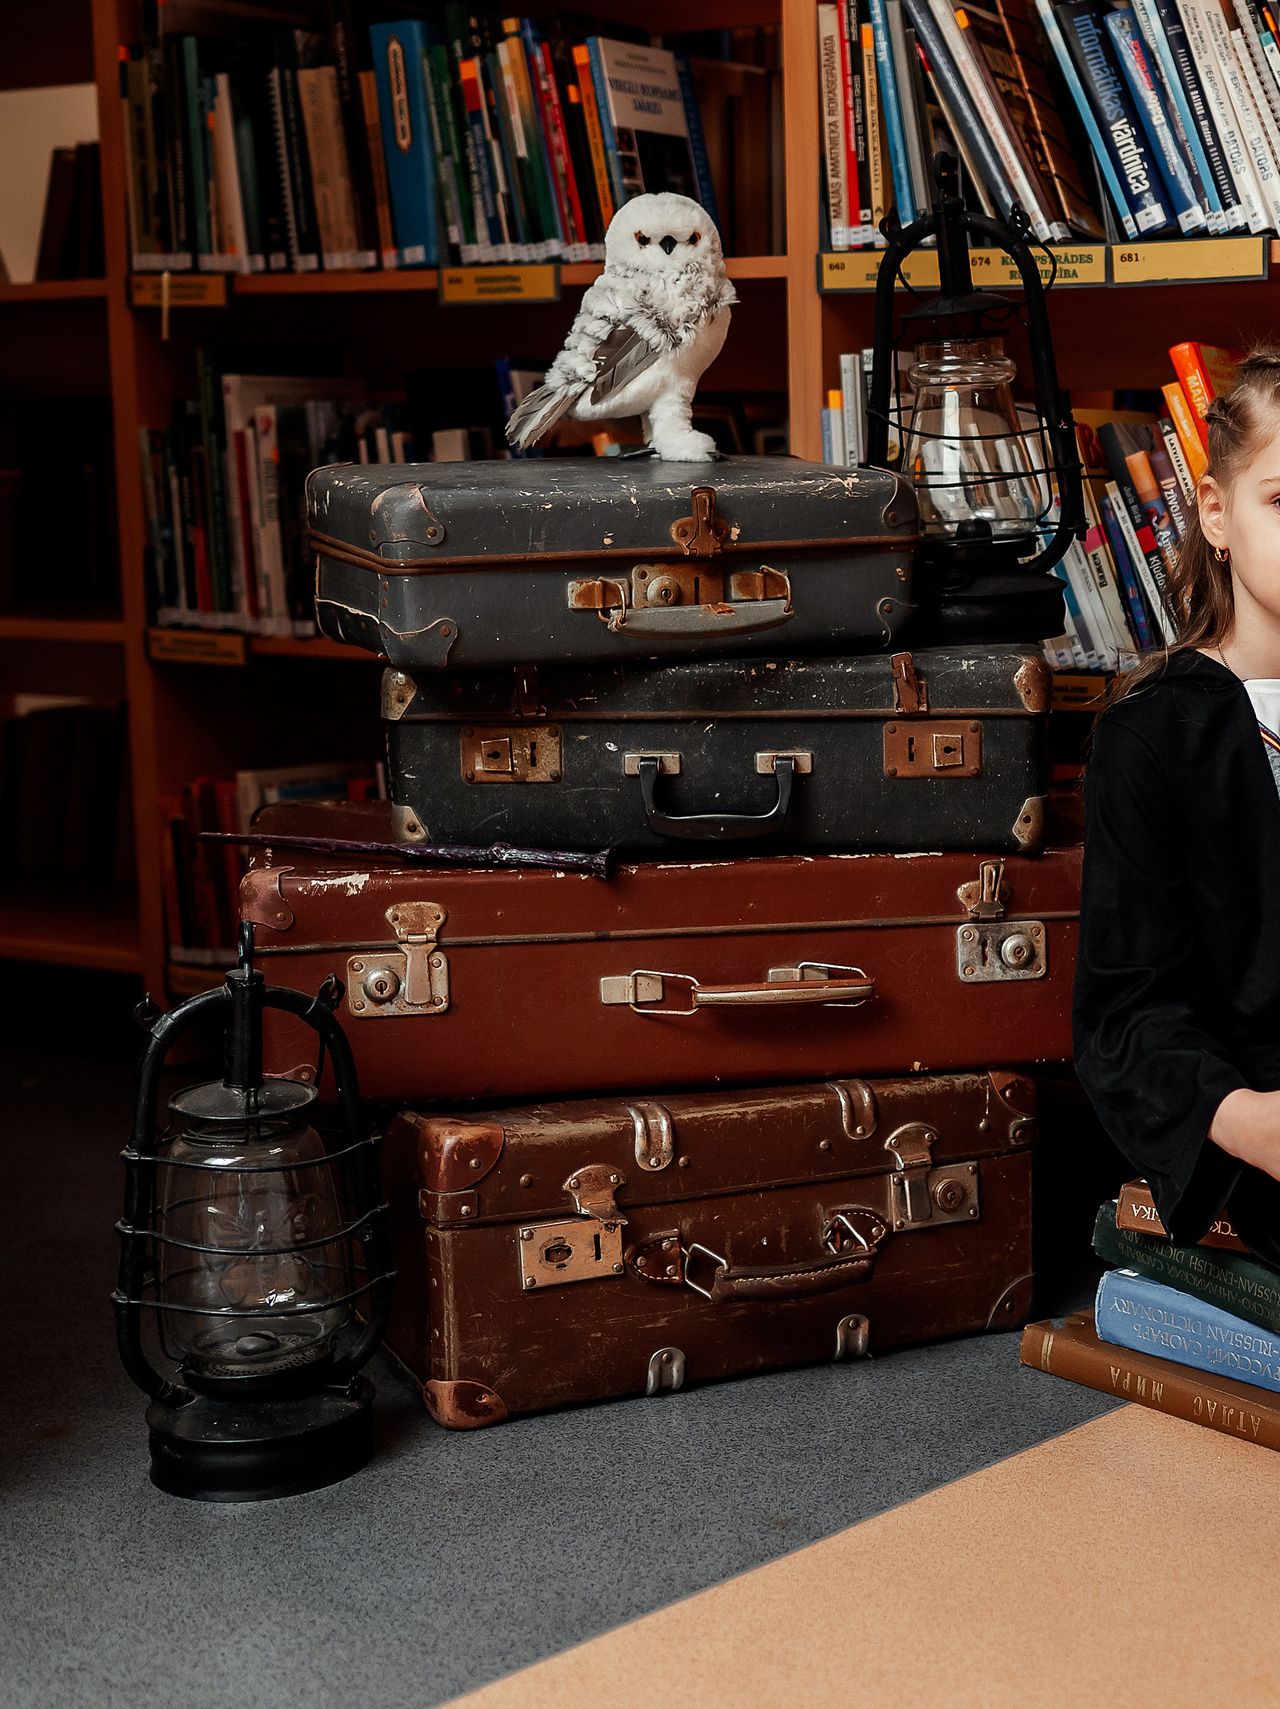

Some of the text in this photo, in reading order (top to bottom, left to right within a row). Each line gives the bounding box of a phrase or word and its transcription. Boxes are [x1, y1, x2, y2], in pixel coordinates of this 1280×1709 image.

[823, 35, 839, 117] ROKASGRĀMATA
[1073, 13, 1150, 195] informātikas vārdnīca
[828, 120, 842, 179] AMATNIEKA
[1225, 131, 1246, 175] DATORS
[1250, 136, 1273, 181] DATORS
[971, 255, 991, 267] 674
[1120, 253, 1140, 263] 681
[1168, 437, 1191, 493] LATVIEŠU-ANG
[1160, 477, 1187, 537] DZĪVOJAM
[1092, 552, 1108, 588] Вяжем
[1118, 1242, 1164, 1271] СЛОВАРЬ
[1121, 1230, 1185, 1263] DICTIONARY
[1110, 1296, 1203, 1336] DICTIONARY
[1132, 1323, 1203, 1355] СЛОВАРЬ
[1110, 1365, 1262, 1437] АТЛАС МИРА
